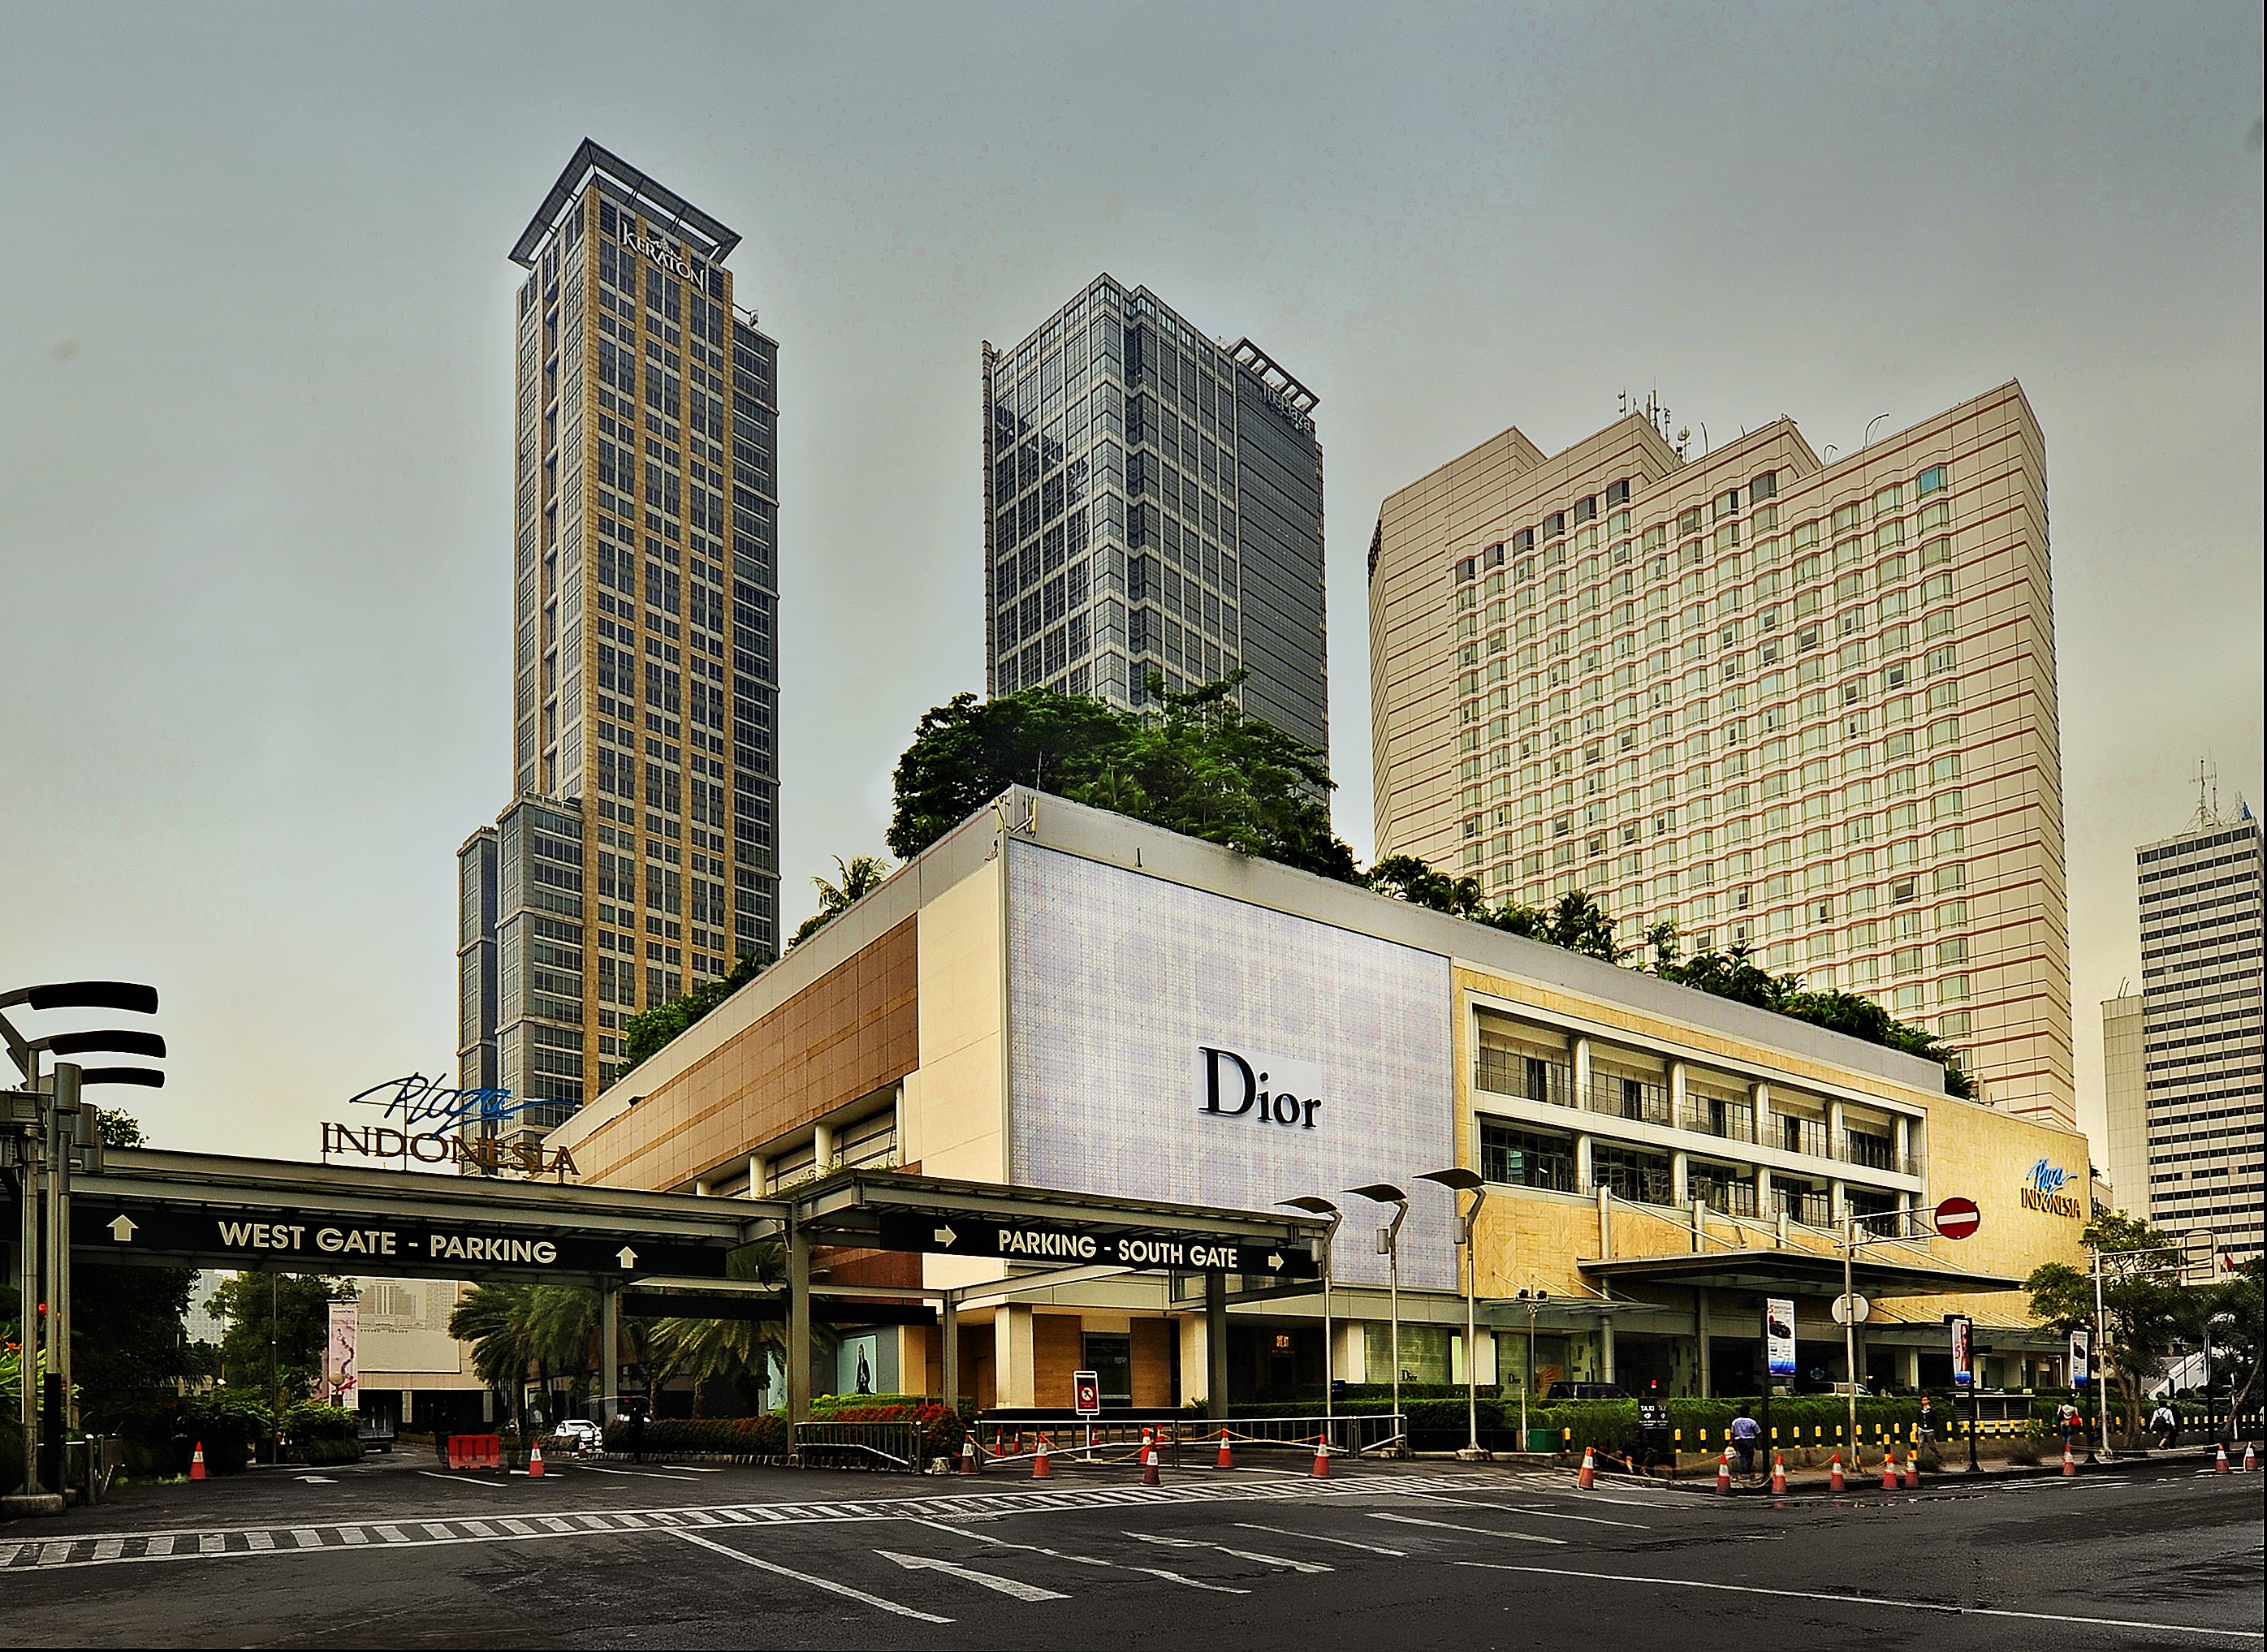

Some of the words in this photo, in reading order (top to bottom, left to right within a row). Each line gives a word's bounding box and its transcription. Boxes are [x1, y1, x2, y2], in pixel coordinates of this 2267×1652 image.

[621, 220, 705, 292] KERATON
[348, 1072, 579, 1140] Plaza
[1198, 1046, 1323, 1128] Dior
[320, 1121, 581, 1176] INDONESIA
[2019, 1186, 2082, 1219] INDONESIA
[218, 1221, 304, 1249] WEST
[316, 1227, 395, 1255] GATE
[430, 1235, 557, 1264] PARKING
[998, 1229, 1097, 1258] PARKING
[1118, 1239, 1184, 1264] SOUTH
[1190, 1245, 1238, 1268] GATE
